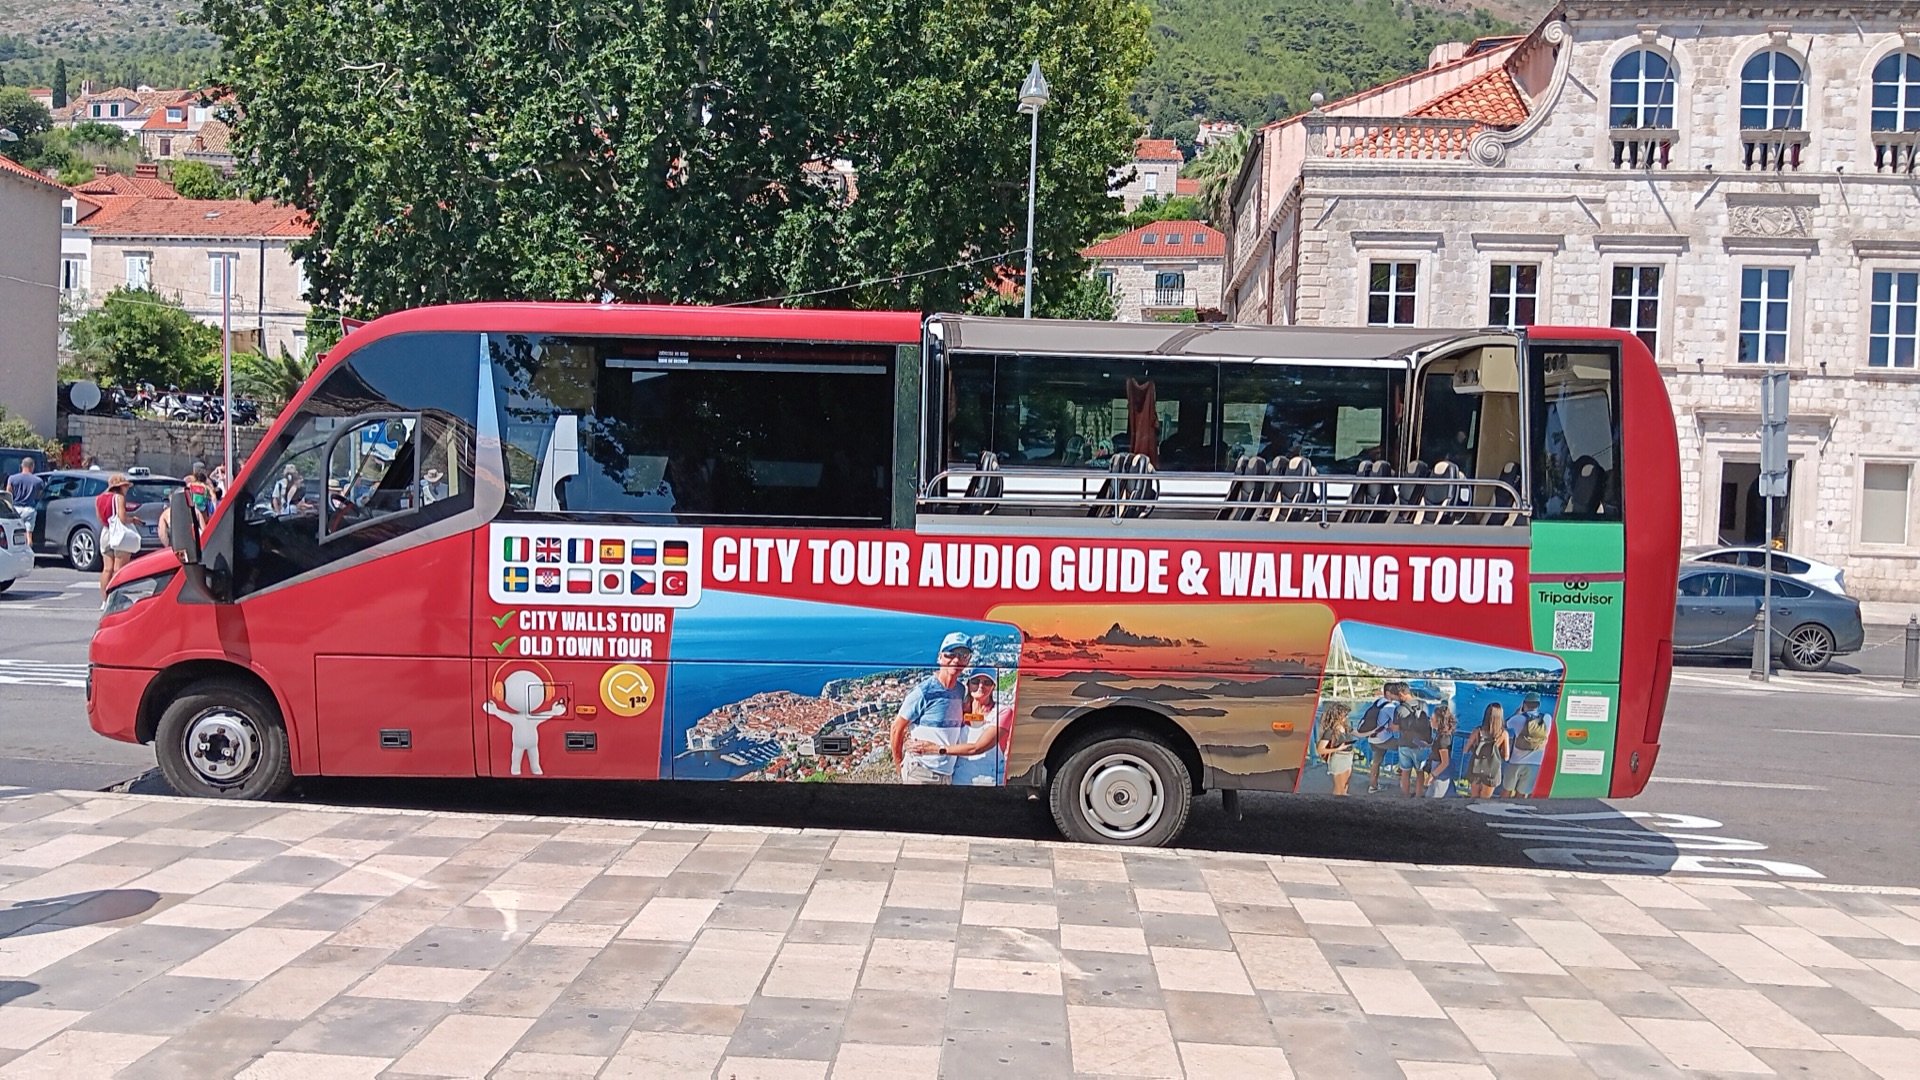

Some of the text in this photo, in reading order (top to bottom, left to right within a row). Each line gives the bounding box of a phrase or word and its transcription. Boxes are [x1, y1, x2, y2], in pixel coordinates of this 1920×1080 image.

[712, 536, 1514, 604] CITY TOUR AUDIO GUIDE & WALKING TOUR
[1538, 591, 1613, 605] Tripadvisor
[519, 610, 666, 633] CITY WALLS TOUR
[519, 636, 652, 658] OLD TOWN TOUR
[1466, 802, 1827, 879] BUS
